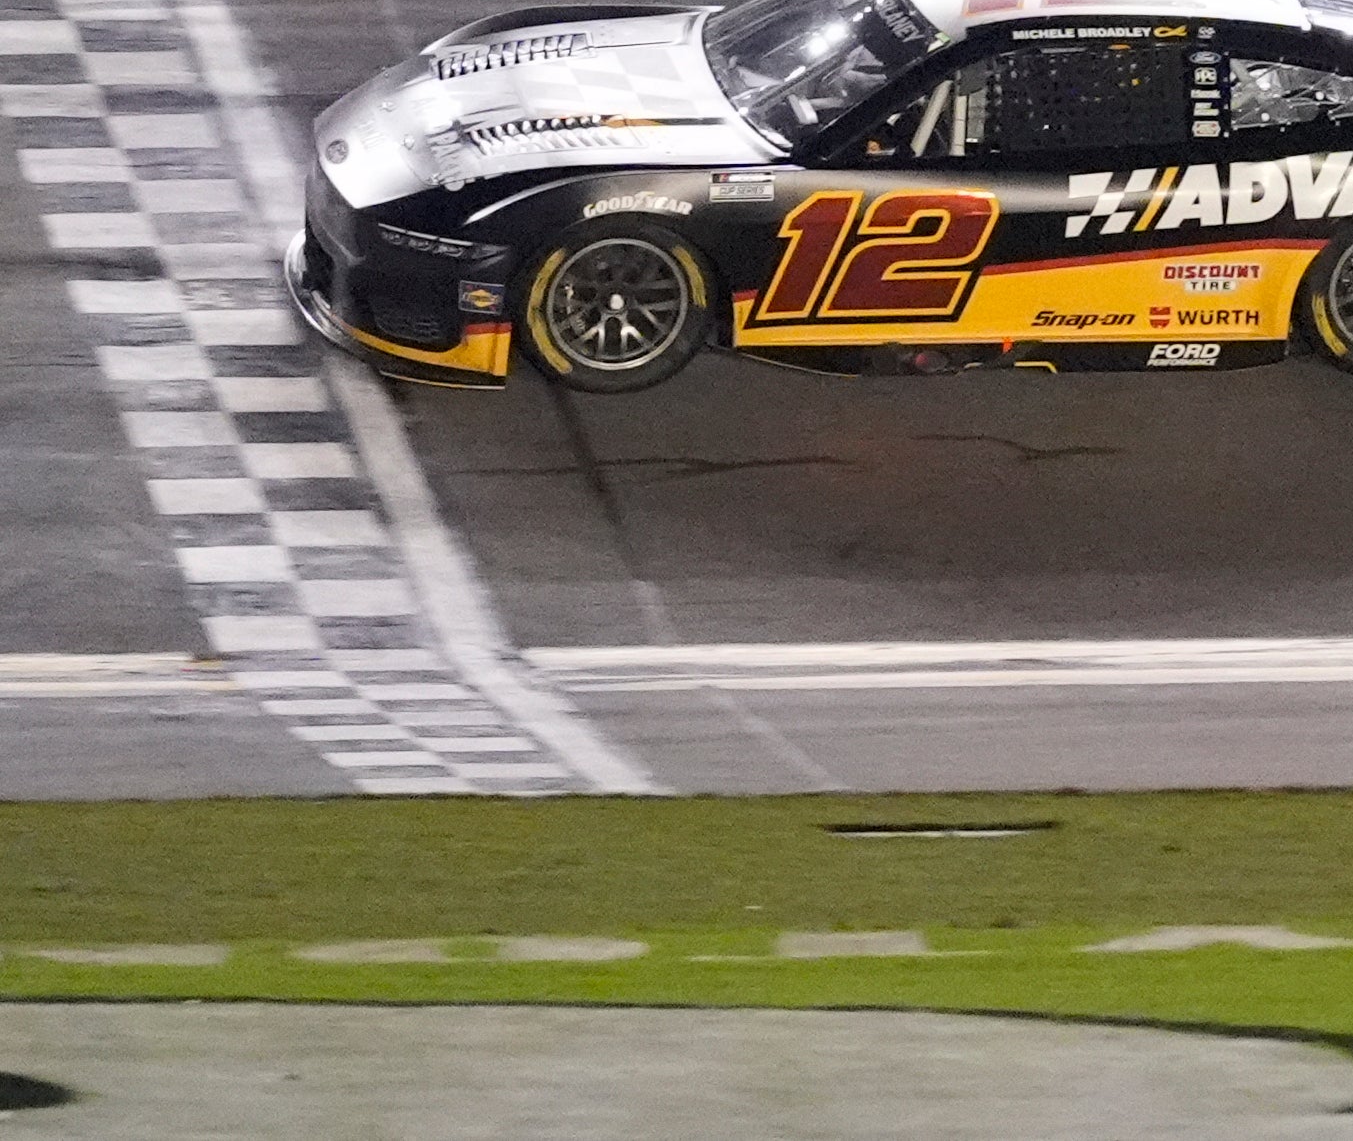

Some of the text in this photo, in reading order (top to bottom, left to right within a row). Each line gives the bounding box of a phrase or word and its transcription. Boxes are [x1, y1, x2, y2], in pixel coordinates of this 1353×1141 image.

[1012, 25, 1152, 41] MICHELE BROADLEY
[583, 191, 693, 219] GOODYEAR
[742, 187, 1001, 329] 12
[1163, 265, 1261, 282] DISCOUNT
[1190, 280, 1233, 291] TIRE
[1031, 310, 1136, 331] Snap-on
[1149, 343, 1221, 359] FORD
